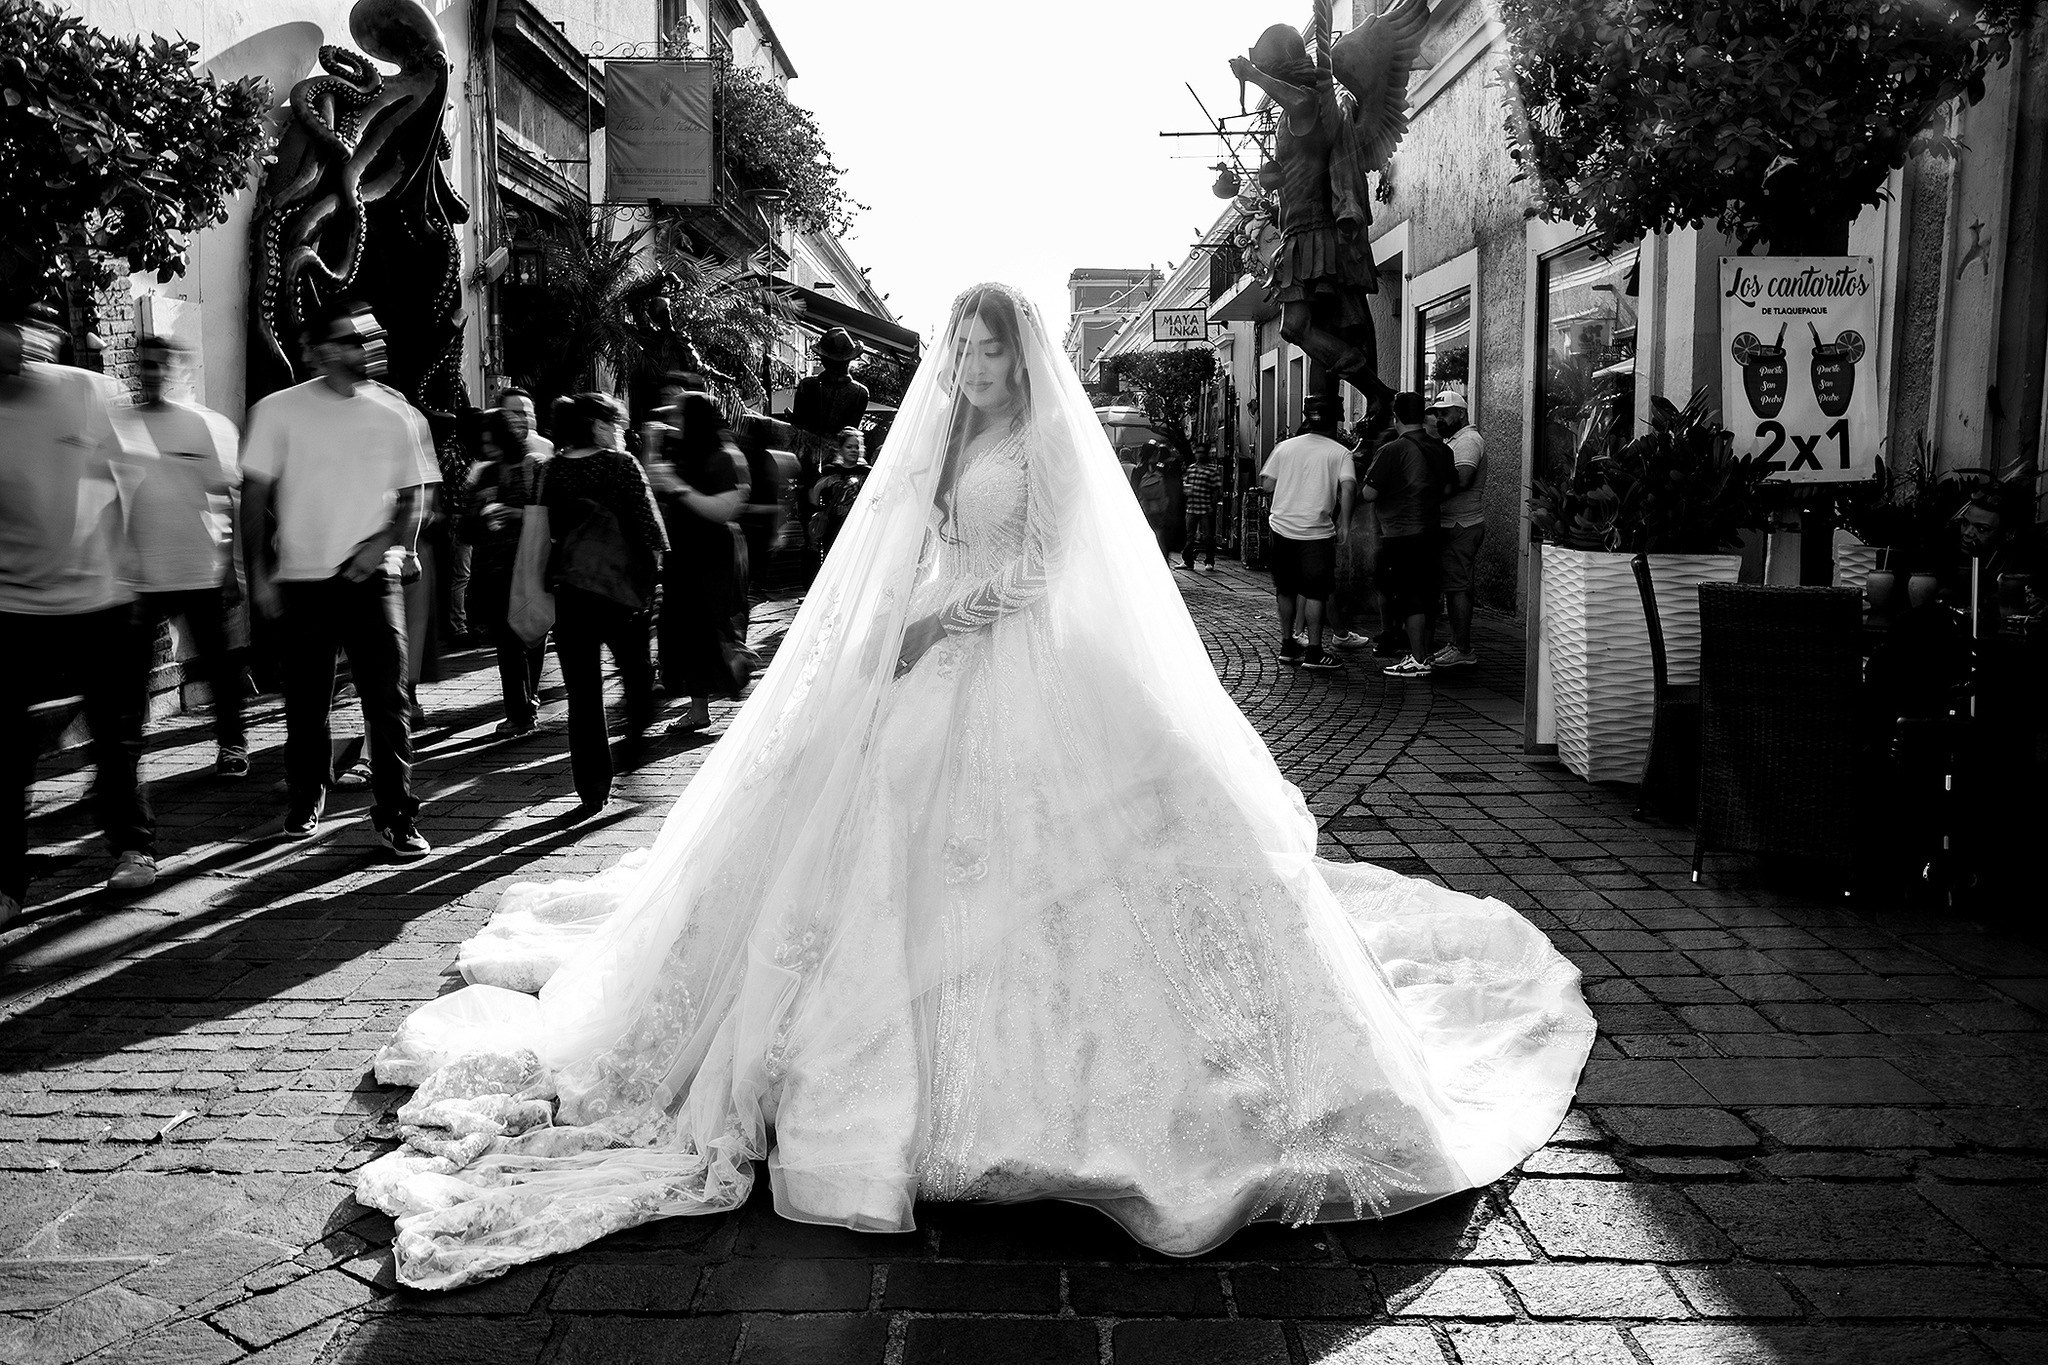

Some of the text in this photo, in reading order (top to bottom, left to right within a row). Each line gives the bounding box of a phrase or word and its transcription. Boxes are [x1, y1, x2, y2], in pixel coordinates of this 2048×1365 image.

[1725, 265, 1870, 308] Los cantaritos
[1773, 307, 1828, 315] TLAQUEPAQUE
[1161, 314, 1199, 327] MAYA
[1170, 325, 1200, 336] INKA
[1760, 381, 1776, 391] San
[1818, 379, 1833, 390] San
[1760, 395, 1783, 405] Pedro
[1818, 393, 1840, 404] Pedro
[1755, 418, 1850, 472] 2x1
